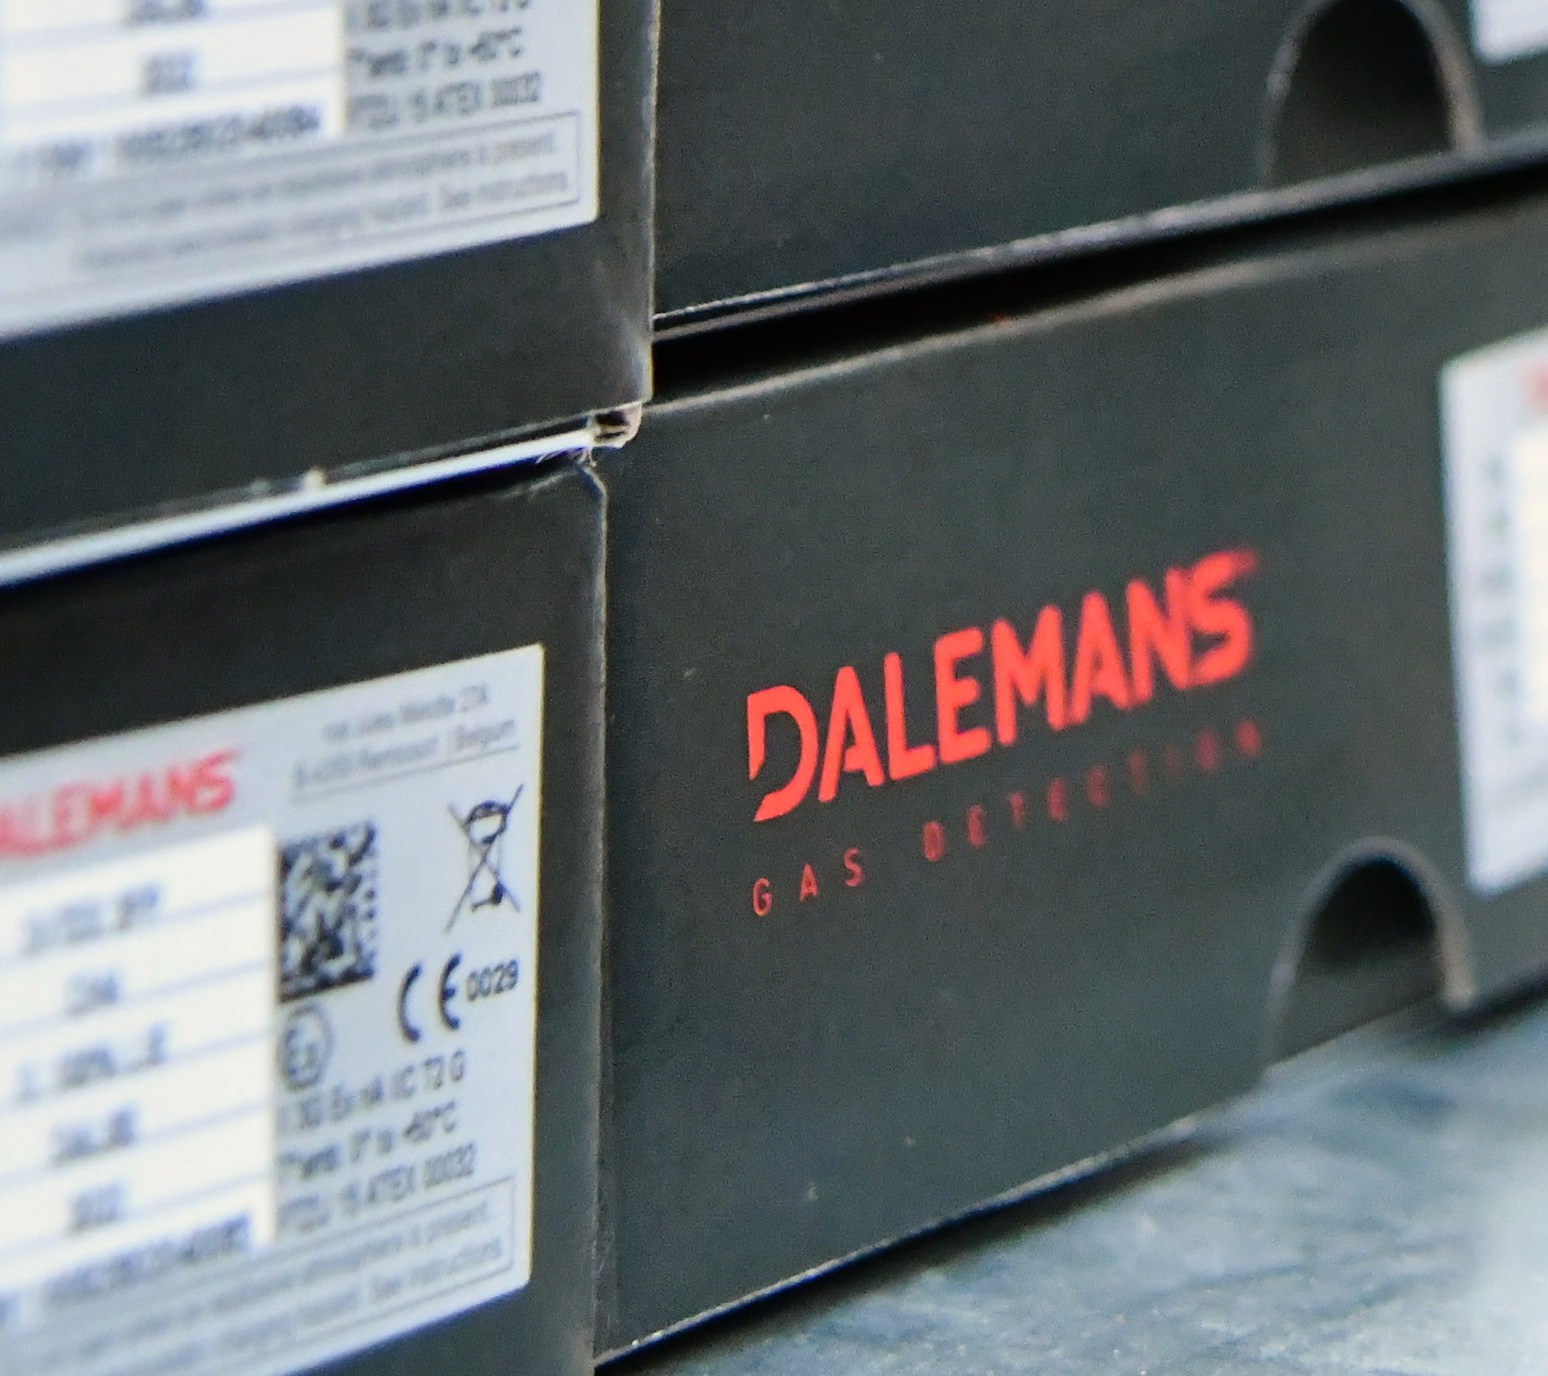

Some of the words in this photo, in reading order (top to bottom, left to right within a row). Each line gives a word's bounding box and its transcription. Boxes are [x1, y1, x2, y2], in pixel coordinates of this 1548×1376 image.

[747, 547, 1257, 822] DALEMANS
[752, 848, 865, 917] GAS
[467, 962, 519, 1002] 0029
